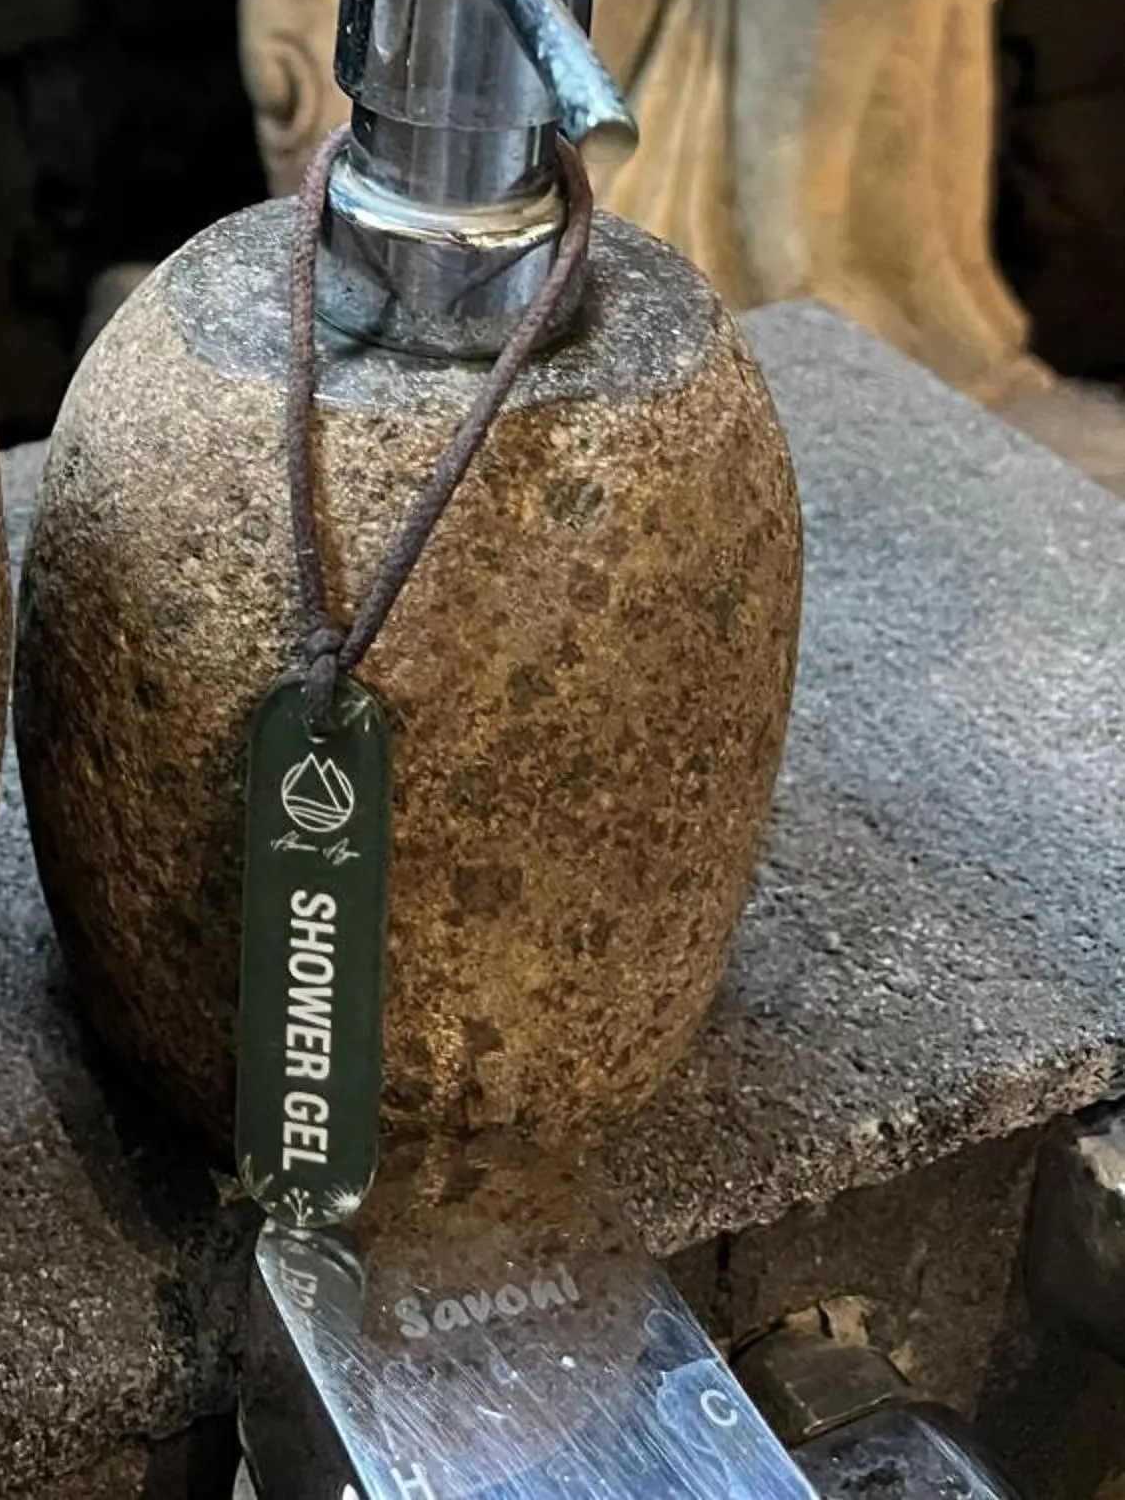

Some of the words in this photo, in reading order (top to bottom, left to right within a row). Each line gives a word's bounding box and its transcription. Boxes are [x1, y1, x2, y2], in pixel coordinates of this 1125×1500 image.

[284, 889, 337, 1081] SHOWER
[282, 1095, 330, 1172] GEL
[699, 1389, 739, 1427] C
[389, 1462, 436, 1500] H
